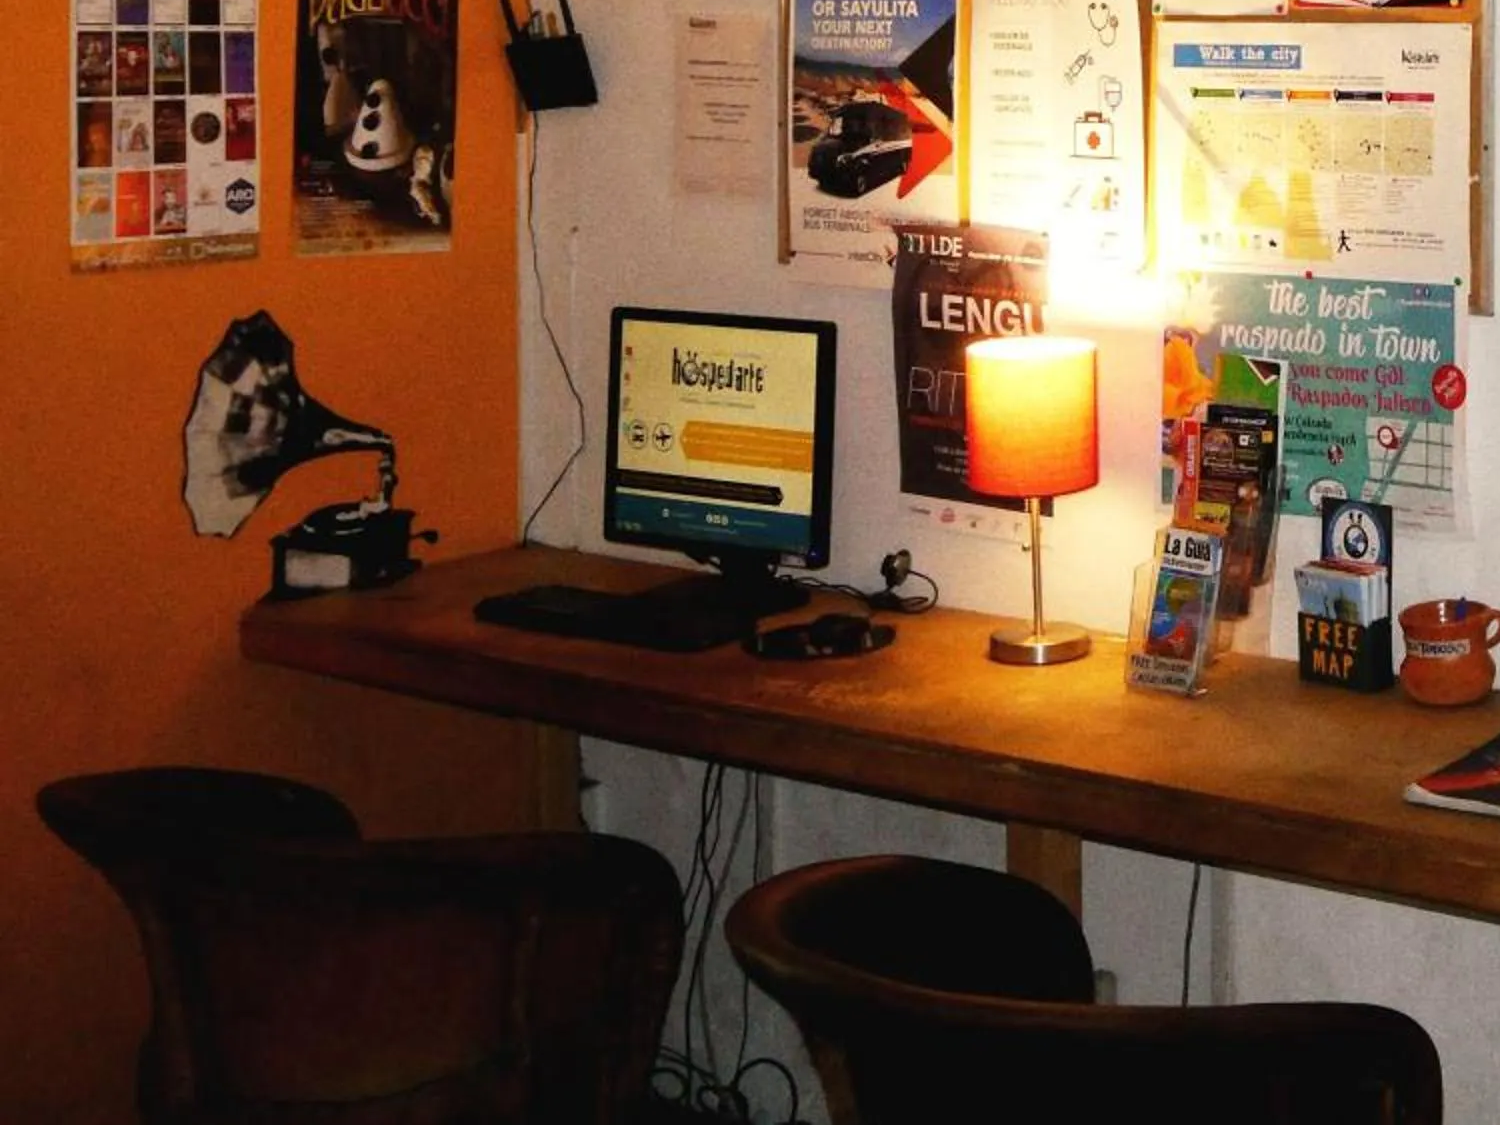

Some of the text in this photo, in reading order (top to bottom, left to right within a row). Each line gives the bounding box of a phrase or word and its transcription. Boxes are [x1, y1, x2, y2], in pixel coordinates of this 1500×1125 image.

[813, 0, 919, 18] OR SAYULITA
[813, 19, 893, 35] YOUR NEXT
[1200, 45, 1298, 65] Walk the city
[1263, 279, 1386, 320] the best
[1220, 322, 1441, 363] raspado in town
[1164, 533, 1181, 556] La
[1305, 618, 1358, 651] FREE
[1313, 649, 1354, 679] MAP
